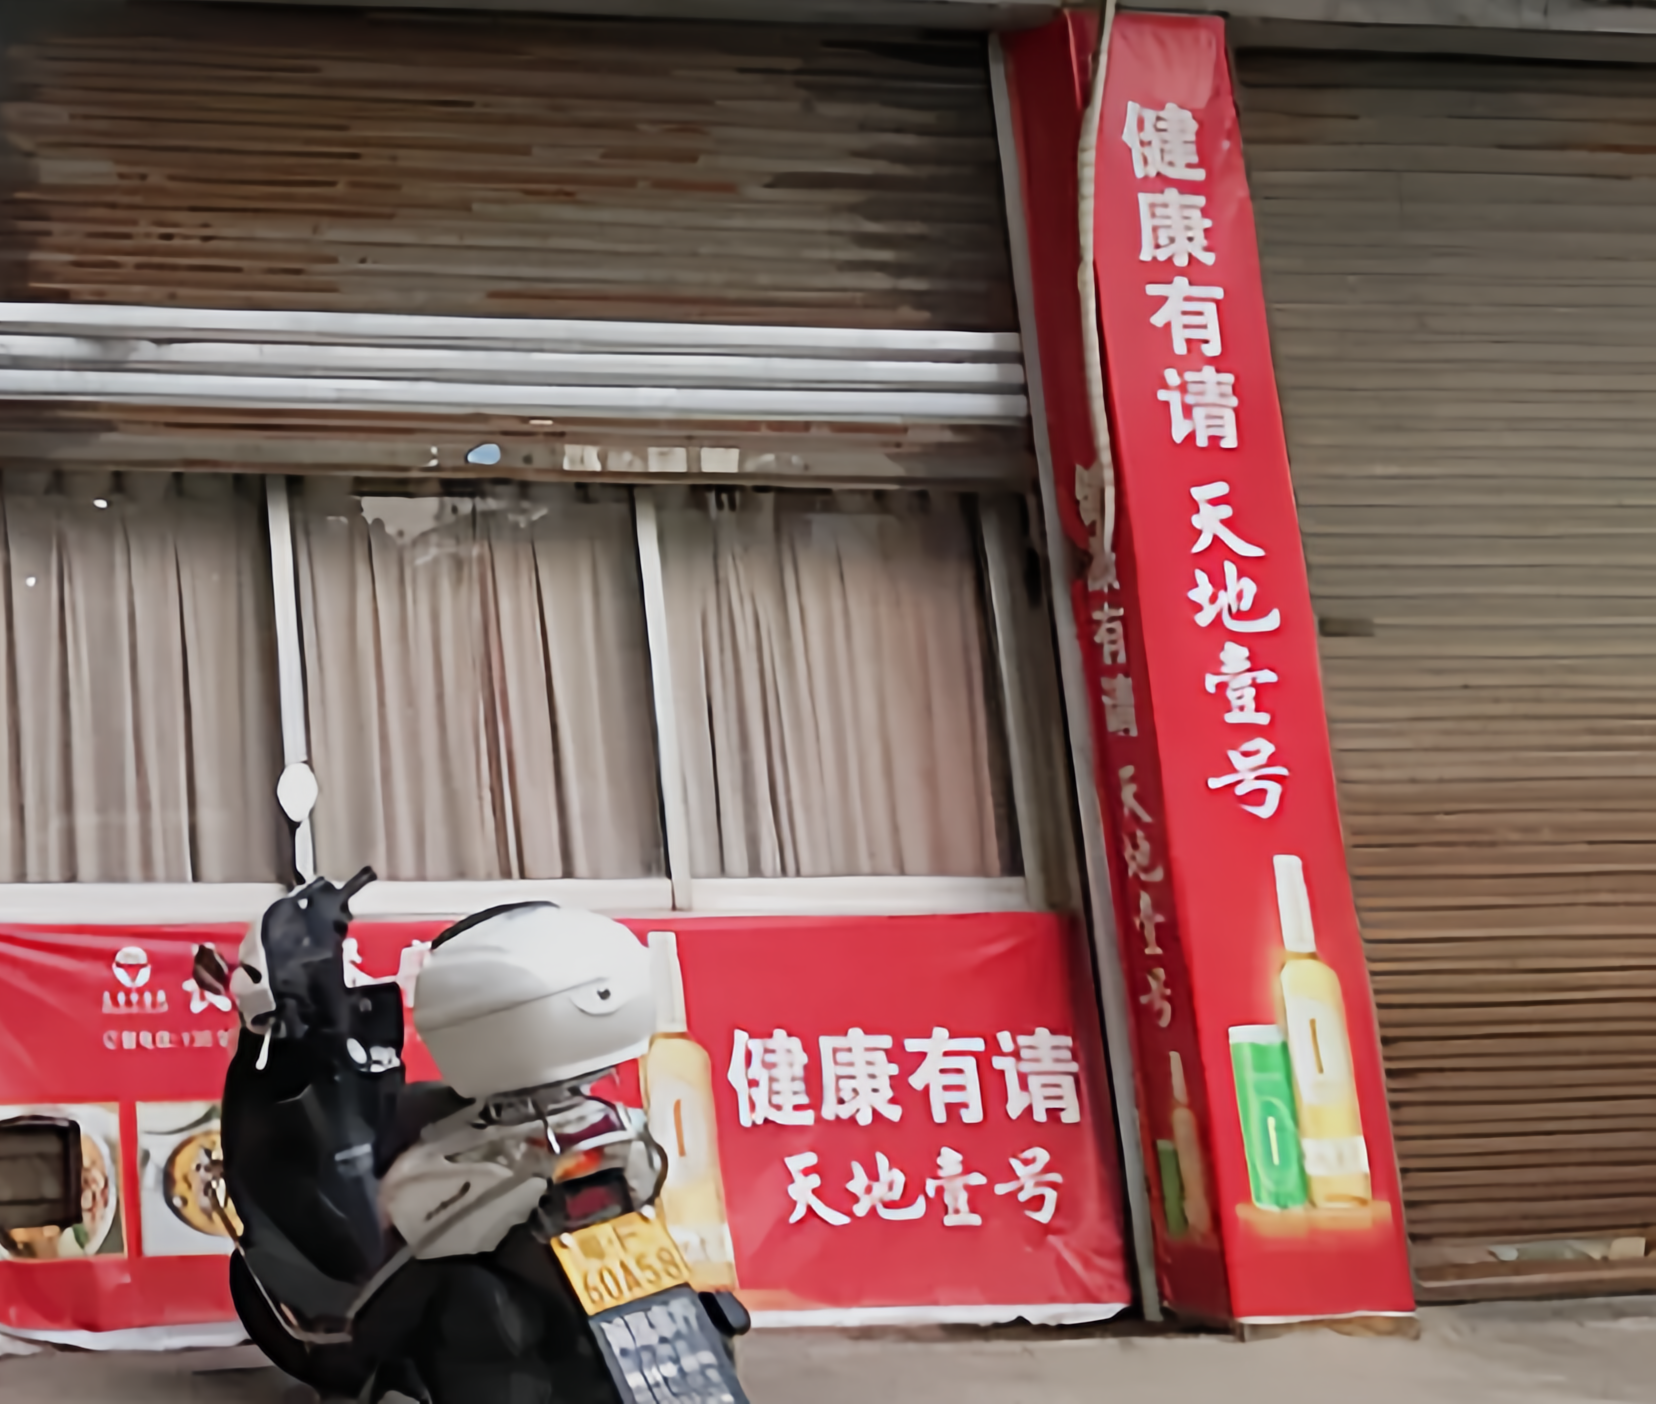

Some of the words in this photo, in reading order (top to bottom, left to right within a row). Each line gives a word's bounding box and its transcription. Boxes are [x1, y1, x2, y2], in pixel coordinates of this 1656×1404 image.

[1121, 100, 1240, 450] 健康有请
[1187, 481, 1291, 820] 天地壹号
[726, 1026, 1082, 1127] 健康有请
[782, 1145, 1064, 1227] 天地壹号
